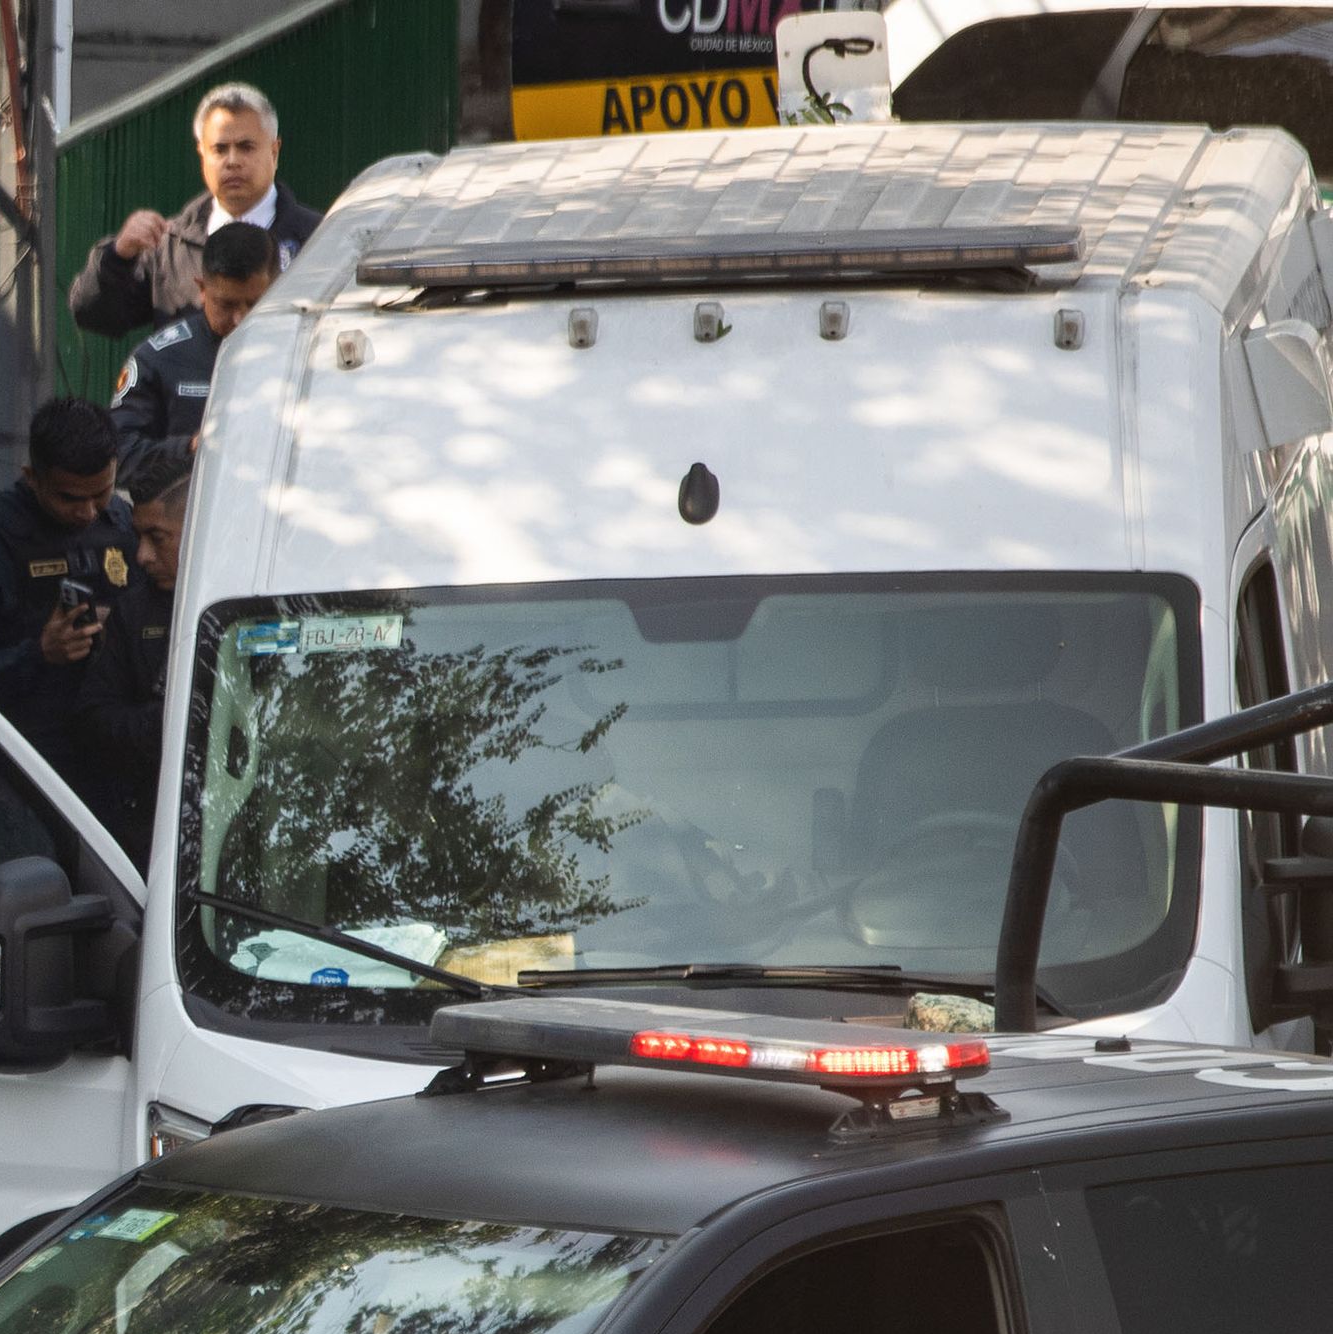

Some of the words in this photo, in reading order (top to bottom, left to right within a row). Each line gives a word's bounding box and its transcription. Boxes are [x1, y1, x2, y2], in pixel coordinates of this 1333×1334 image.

[691, 37, 723, 52] CIUDAD
[726, 38, 738, 52] DE
[602, 80, 750, 135] APOYO
